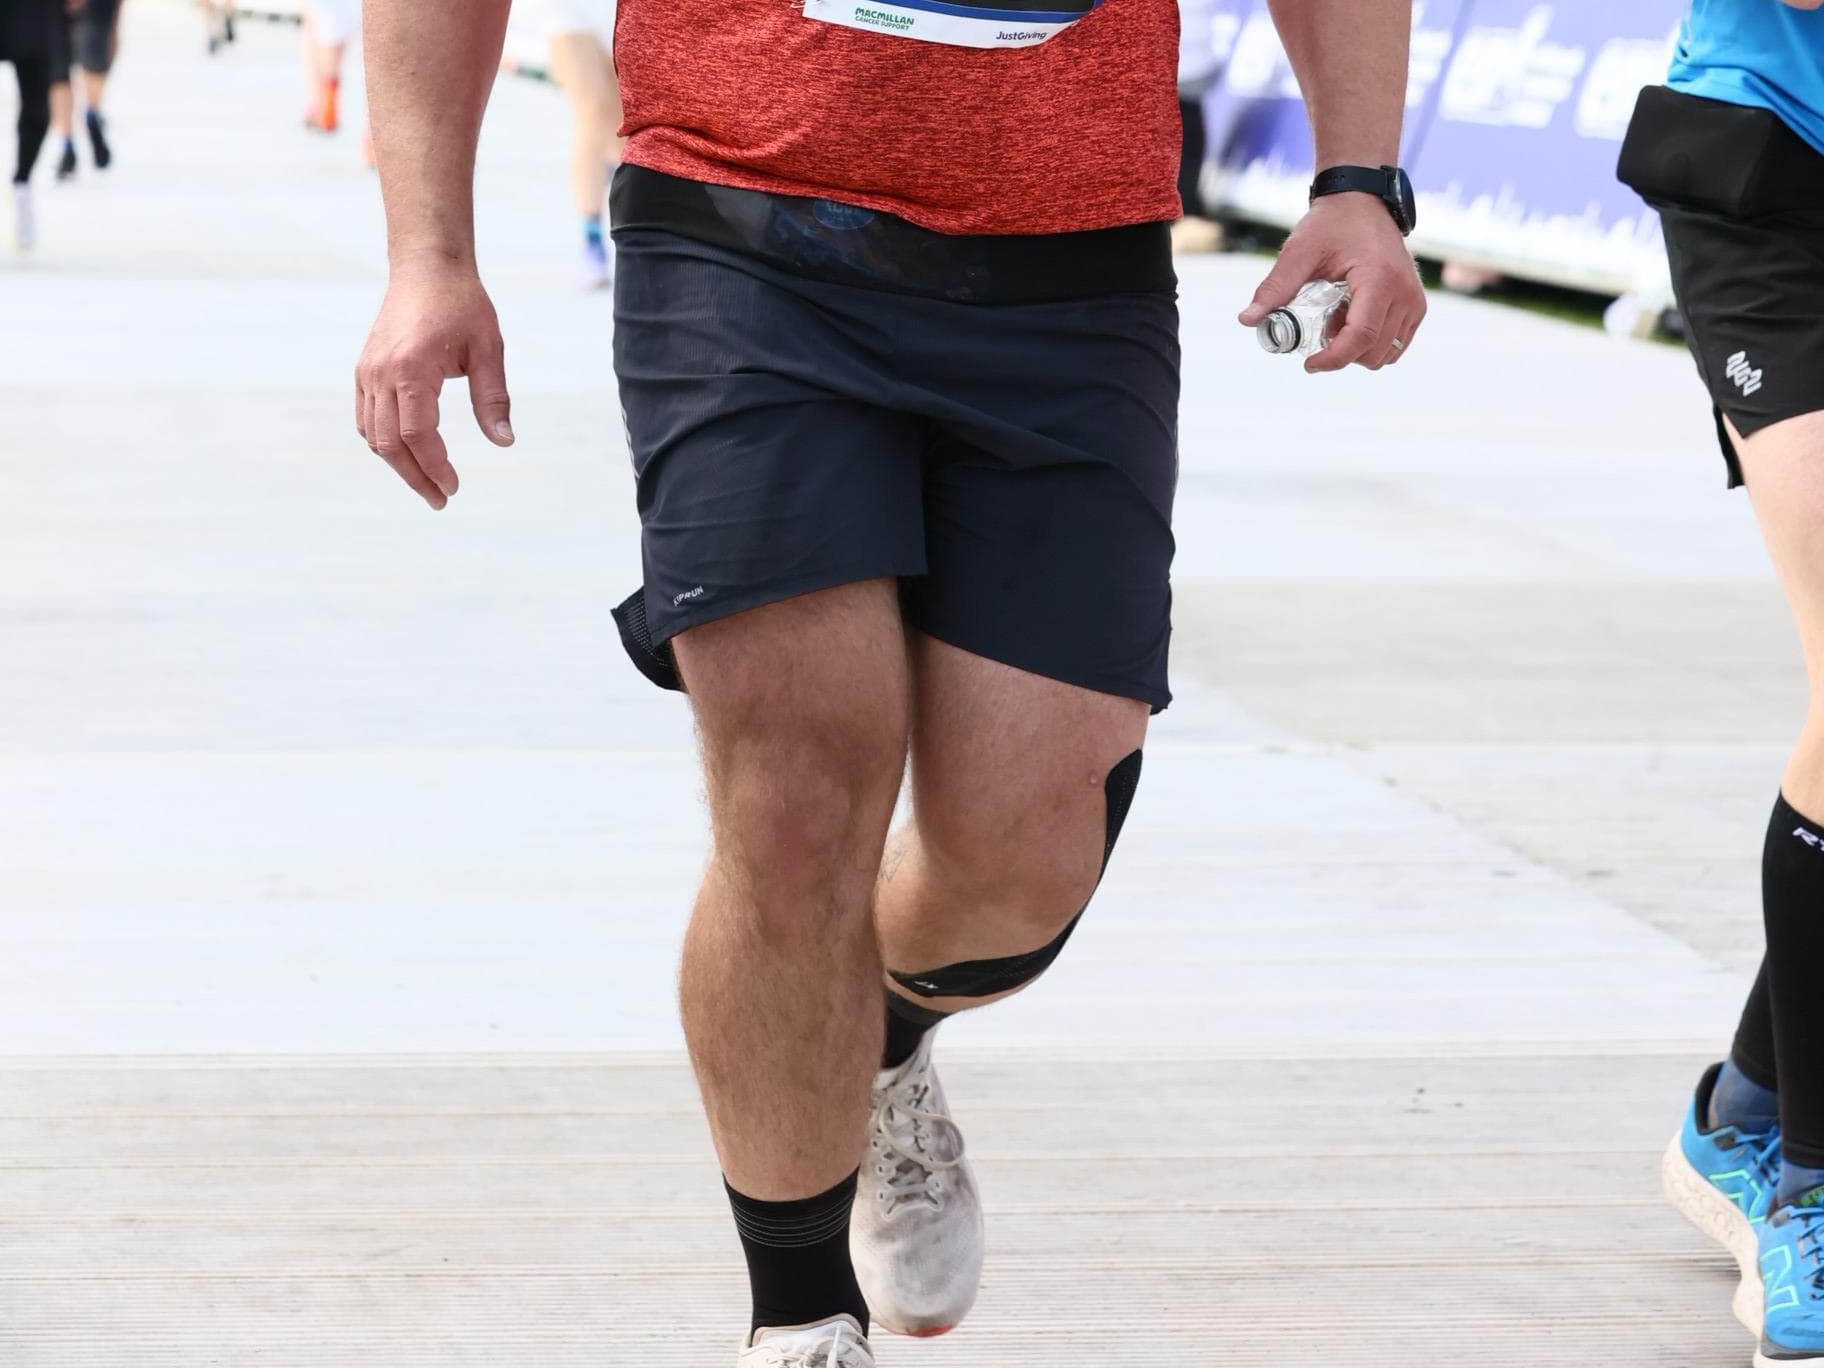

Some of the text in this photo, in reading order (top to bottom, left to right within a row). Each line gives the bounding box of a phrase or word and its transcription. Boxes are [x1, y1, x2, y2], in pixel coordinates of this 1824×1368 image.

[855, 7, 914, 25] MACMILLAN
[855, 15, 910, 30] CANCER SUPPORT
[995, 31, 1047, 40] JustGiving
[1792, 826, 1824, 852] R
